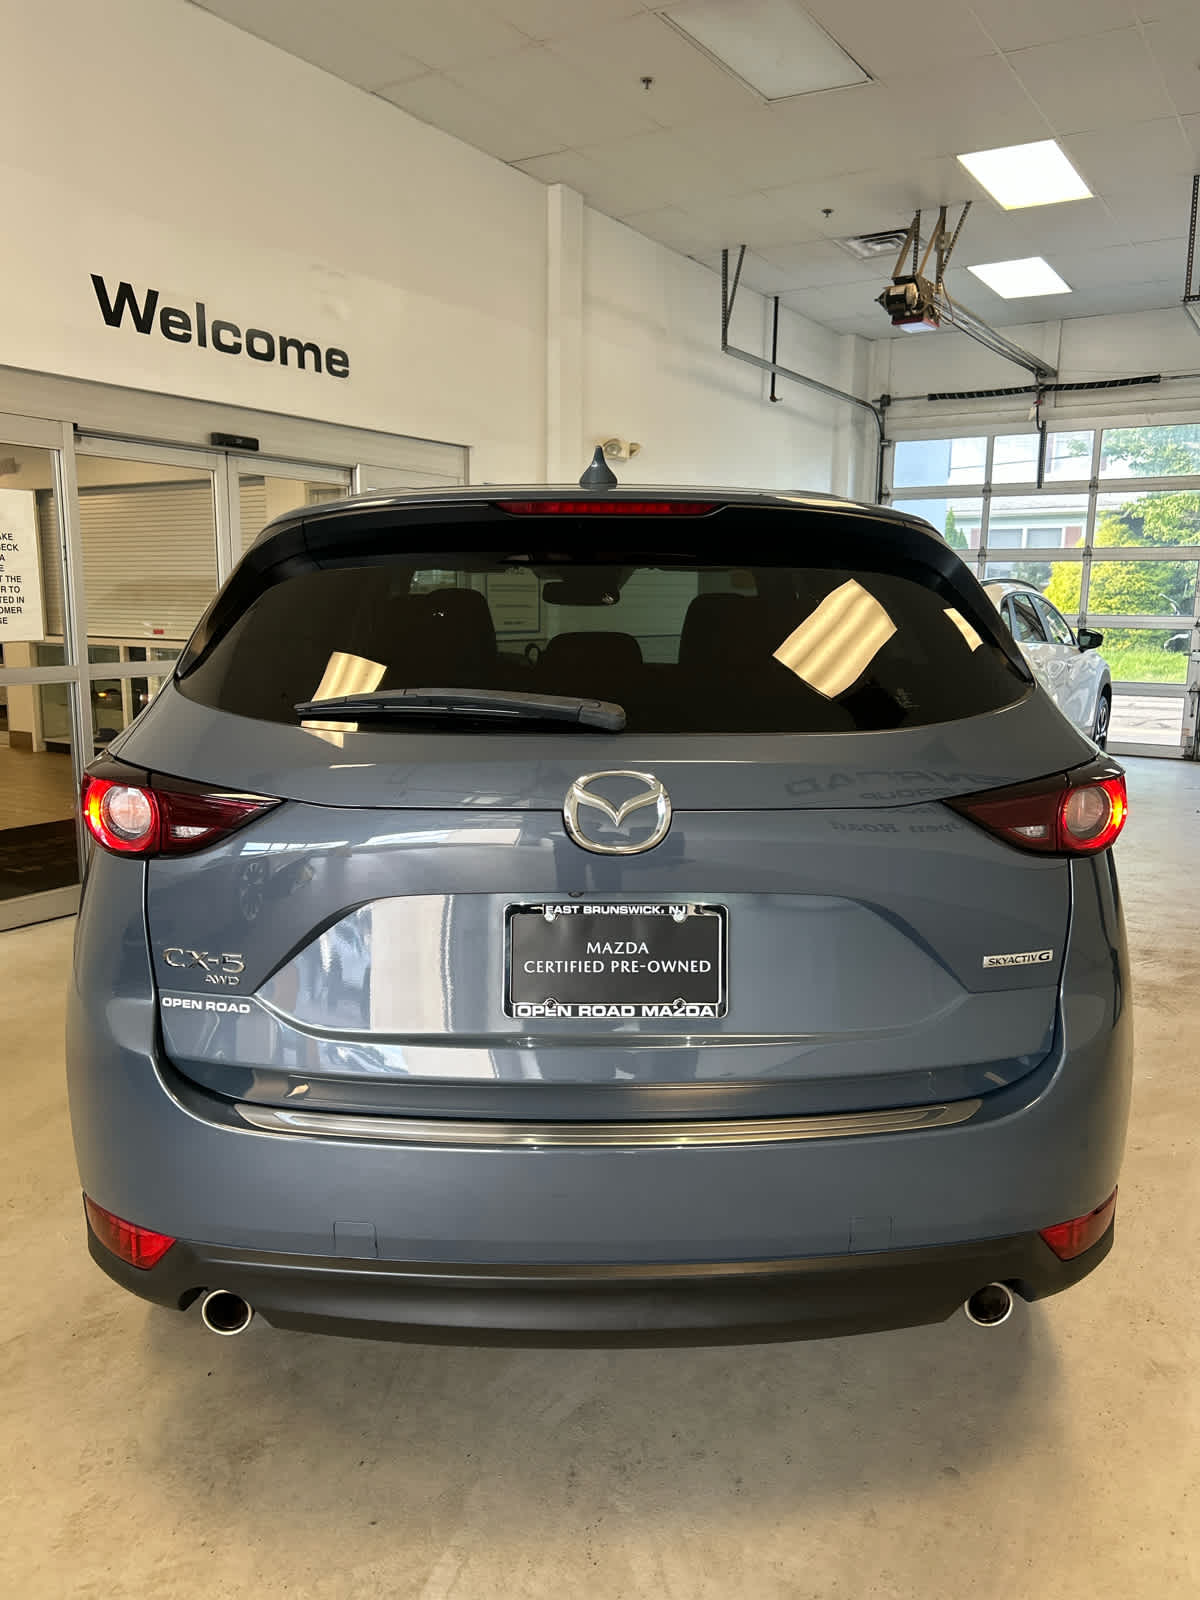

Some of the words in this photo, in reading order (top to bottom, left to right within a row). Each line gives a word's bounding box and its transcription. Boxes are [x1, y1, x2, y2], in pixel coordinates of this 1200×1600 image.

[90, 273, 350, 378] Welcome
[8, 585, 21, 593] TO
[545, 905, 580, 915] EAST
[669, 905, 687, 915] NJ
[586, 941, 649, 954] MAZDA
[162, 947, 245, 973] CX-5
[523, 960, 605, 973] CERTIFIED
[611, 960, 712, 973] PRE-OWNED
[204, 974, 240, 985] AWD
[162, 997, 202, 1010] OPEN
[205, 1001, 251, 1014] ROAD
[516, 1005, 570, 1017] OPEN
[578, 1005, 635, 1017] ROAD
[641, 1005, 715, 1017] MAZDA
